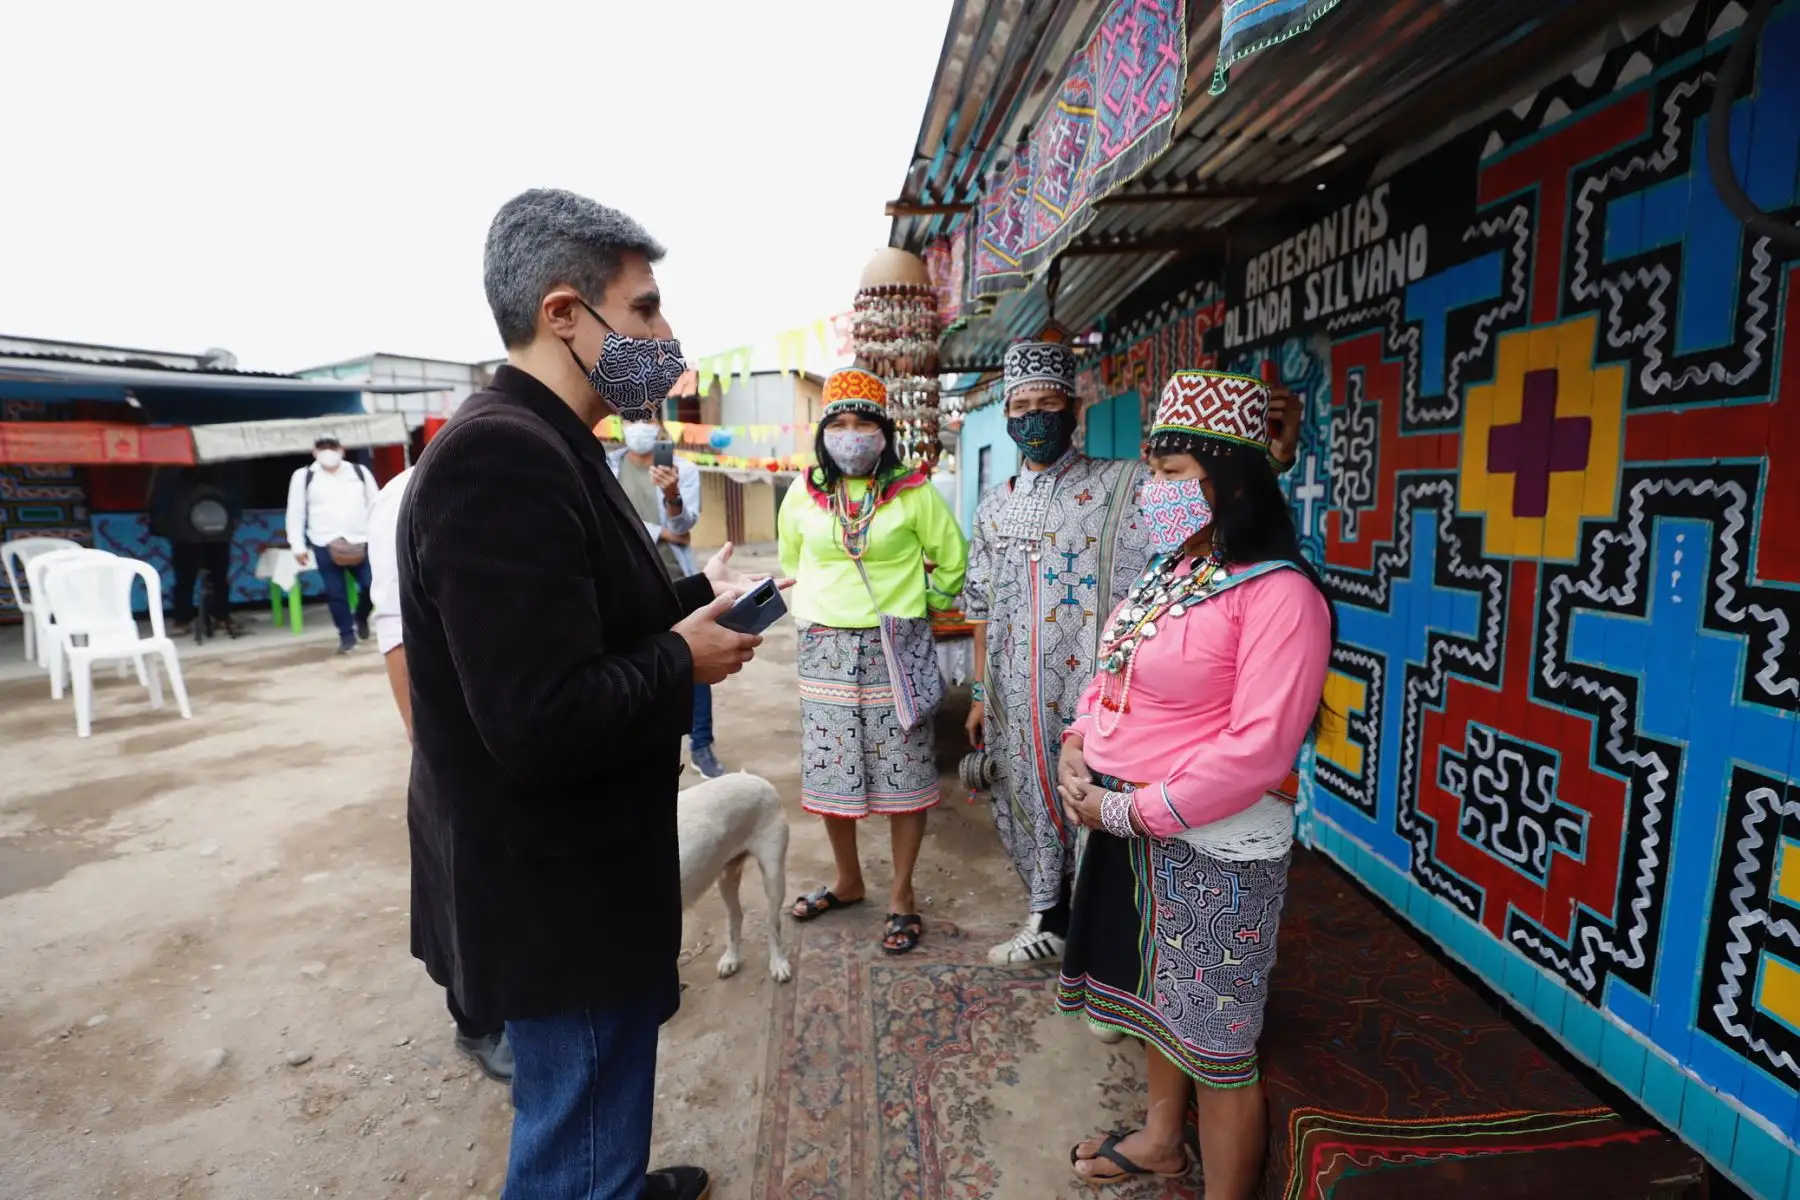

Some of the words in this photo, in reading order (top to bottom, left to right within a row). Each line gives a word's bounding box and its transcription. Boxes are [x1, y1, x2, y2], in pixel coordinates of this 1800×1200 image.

[1223, 285, 1292, 349] OLINDA
[1303, 224, 1428, 321] SILVANO
[1245, 182, 1390, 299] ARTESANIAS
